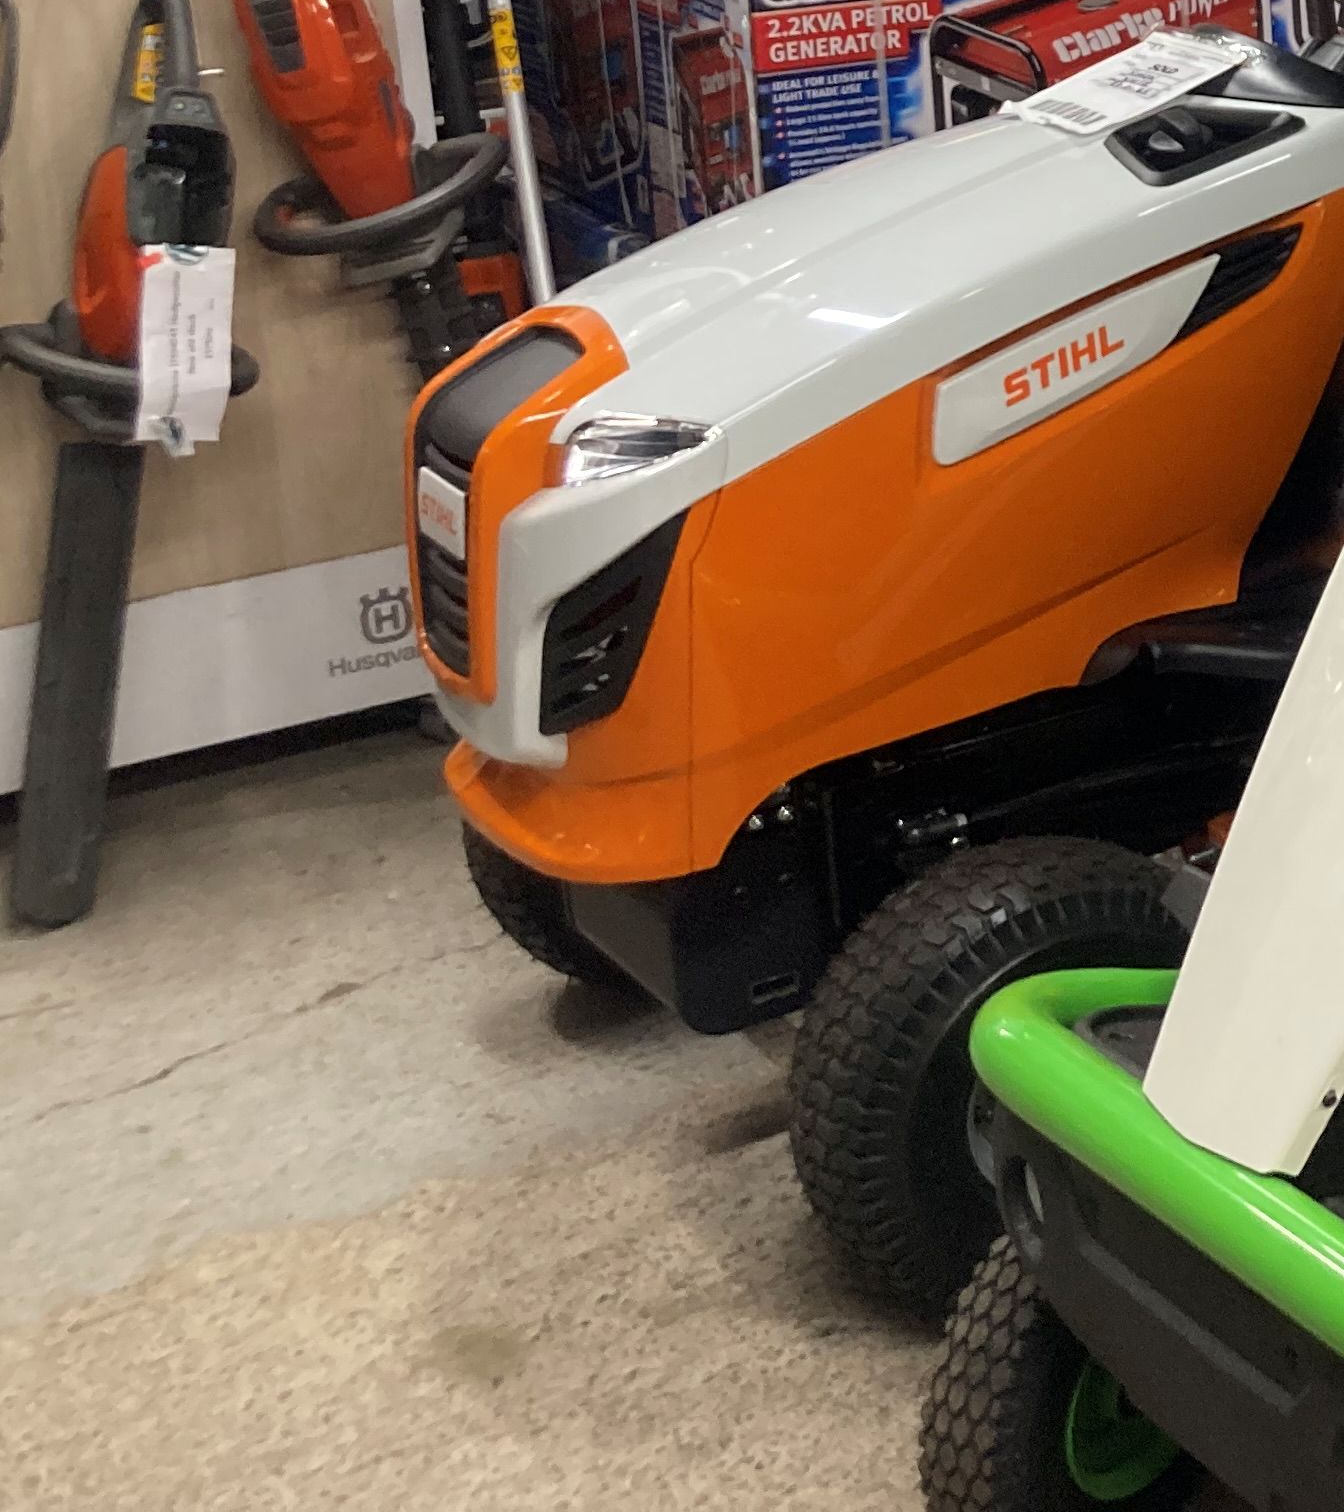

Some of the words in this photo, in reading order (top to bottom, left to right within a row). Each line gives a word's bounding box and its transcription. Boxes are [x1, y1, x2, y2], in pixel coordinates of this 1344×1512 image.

[767, 11, 846, 40] 2.2KVA
[850, 0, 935, 30] PETROL
[1052, 7, 1165, 64] Clarke
[769, 31, 902, 63] GENERATOR
[772, 79, 802, 91] IDEAL
[804, 76, 825, 88] FOR
[827, 71, 870, 85] LEISURE
[772, 91, 803, 104] LIGHT
[806, 86, 838, 100] TRADE
[841, 83, 862, 96] USE
[1003, 325, 1125, 408] STIHL
[420, 492, 457, 536] STIHL
[328, 645, 418, 677] Husqva
